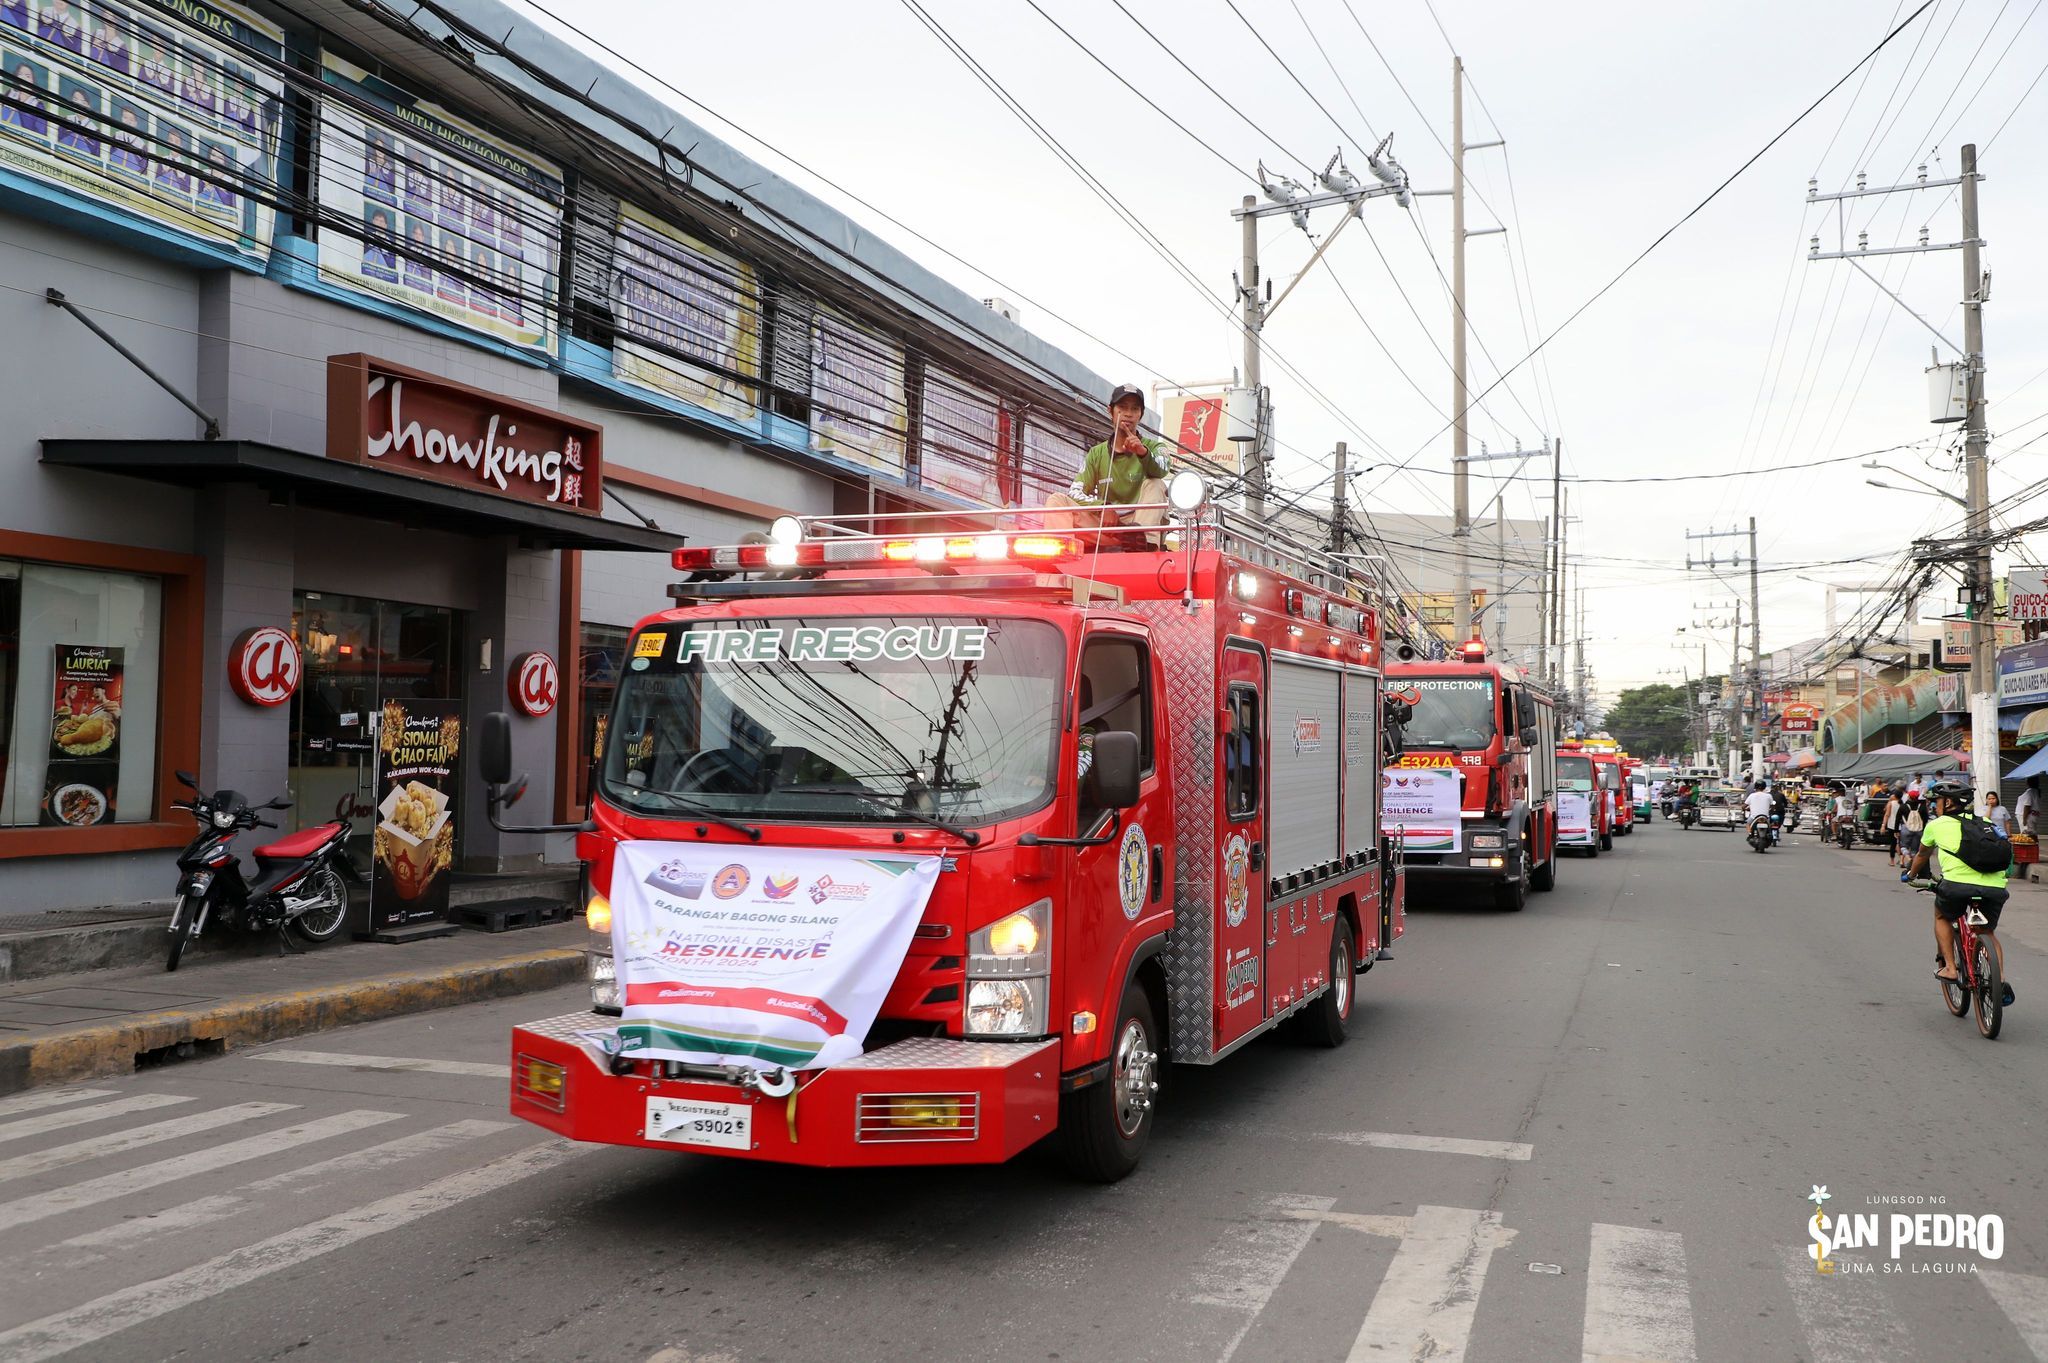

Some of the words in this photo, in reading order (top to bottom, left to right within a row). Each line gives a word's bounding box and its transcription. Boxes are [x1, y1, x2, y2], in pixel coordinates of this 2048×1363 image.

[161, 0, 233, 37] ONORS
[396, 104, 433, 132] WITH
[437, 124, 473, 150] HIGH
[474, 144, 529, 177] HONORS
[368, 376, 562, 502] Chowking
[677, 629, 783, 664] FIRE
[790, 626, 989, 662] RESCUE
[1947, 646, 1972, 655] MEDI
[66, 657, 112, 671] LAURIAT
[249, 639, 292, 695] Ck
[524, 659, 556, 706] Ck
[1413, 681, 1482, 691] PROTECTION
[405, 716, 435, 729] Chowking
[1794, 720, 1807, 728] BPI
[403, 731, 439, 747] SIOMAI
[391, 747, 425, 766] CHAO
[426, 745, 448, 764] FAN
[386, 767, 418, 778] KAKAIBANG
[418, 766, 450, 776] WOK-SARAP
[654, 898, 729, 921] BARANGAY
[729, 911, 787, 924] BAGONG
[790, 915, 839, 925] SILANG
[668, 929, 748, 945] NATIONAL
[756, 930, 834, 947] DISASTR
[716, 957, 760, 967] 2024
[669, 1104, 729, 1116] REGISTERED
